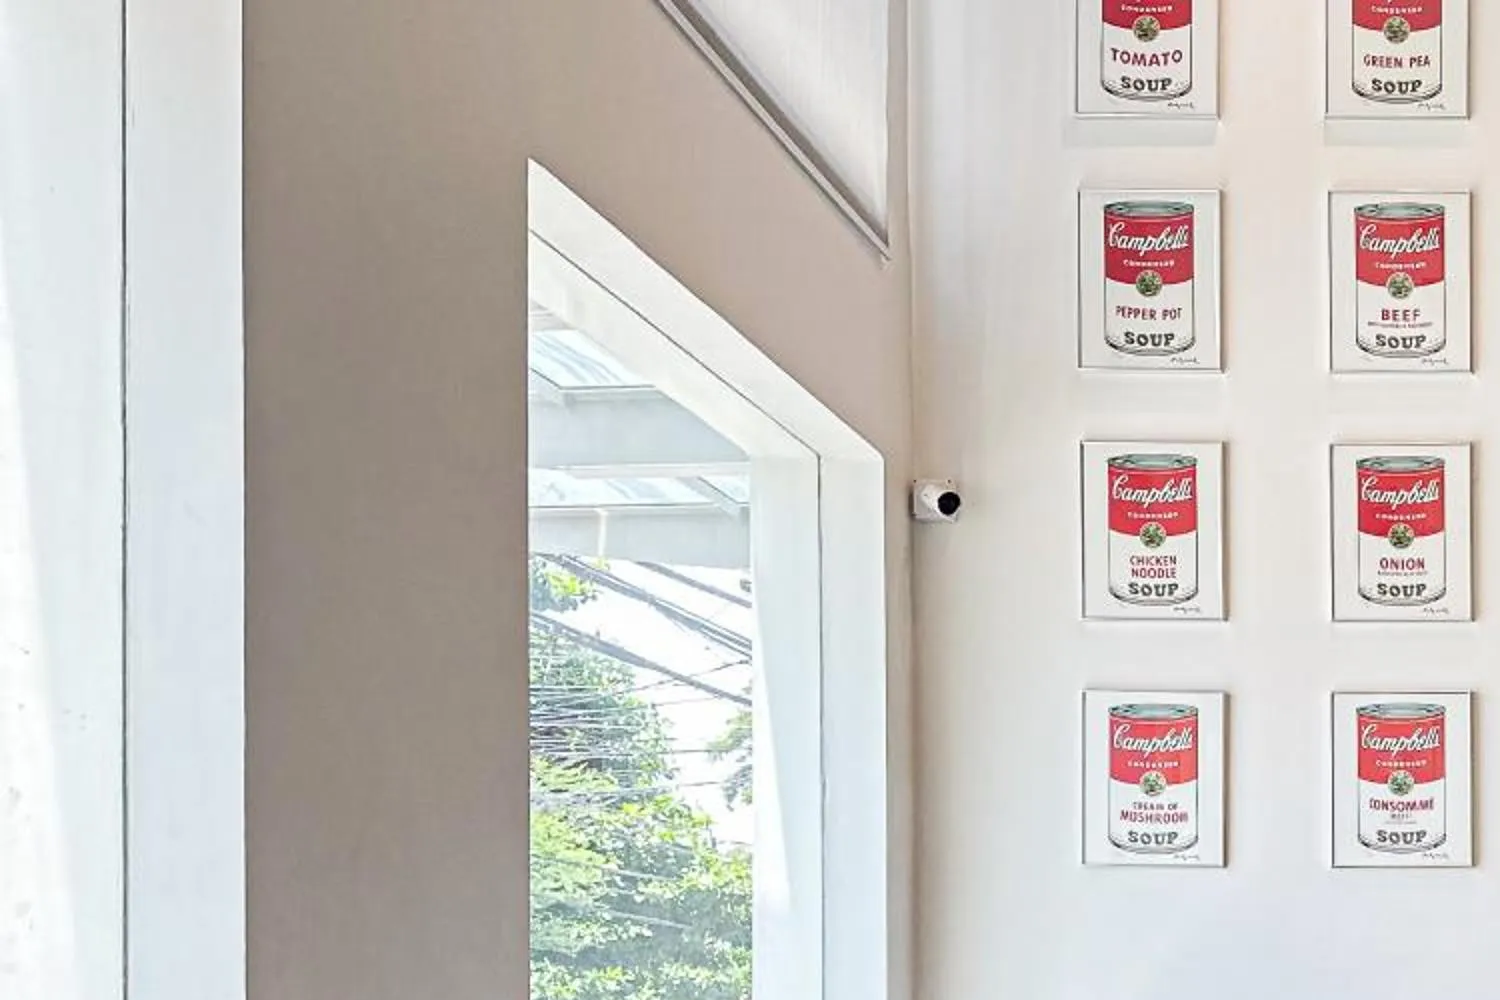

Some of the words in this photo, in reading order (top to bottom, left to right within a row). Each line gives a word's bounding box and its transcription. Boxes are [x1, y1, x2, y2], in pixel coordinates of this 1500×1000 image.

[1110, 47, 1182, 67] TOMATO
[1363, 54, 1402, 68] GREEN
[1409, 55, 1430, 68] PEA
[1120, 75, 1172, 92] SOUP
[1371, 78, 1422, 94] SOUP
[1115, 306, 1157, 321] PEPPER
[1162, 307, 1183, 321] POT
[1381, 308, 1421, 322] BEEF
[1123, 332, 1175, 348] SOUP
[1375, 333, 1427, 349] SOUP
[1129, 555, 1177, 566] CHICKEN
[1379, 557, 1425, 571] ONION
[1131, 568, 1177, 579] NOODLE
[1127, 583, 1179, 597] SOUP
[1376, 583, 1427, 598] SOUP
[1127, 830, 1179, 846] SOUP
[1376, 829, 1427, 845] SOUP
